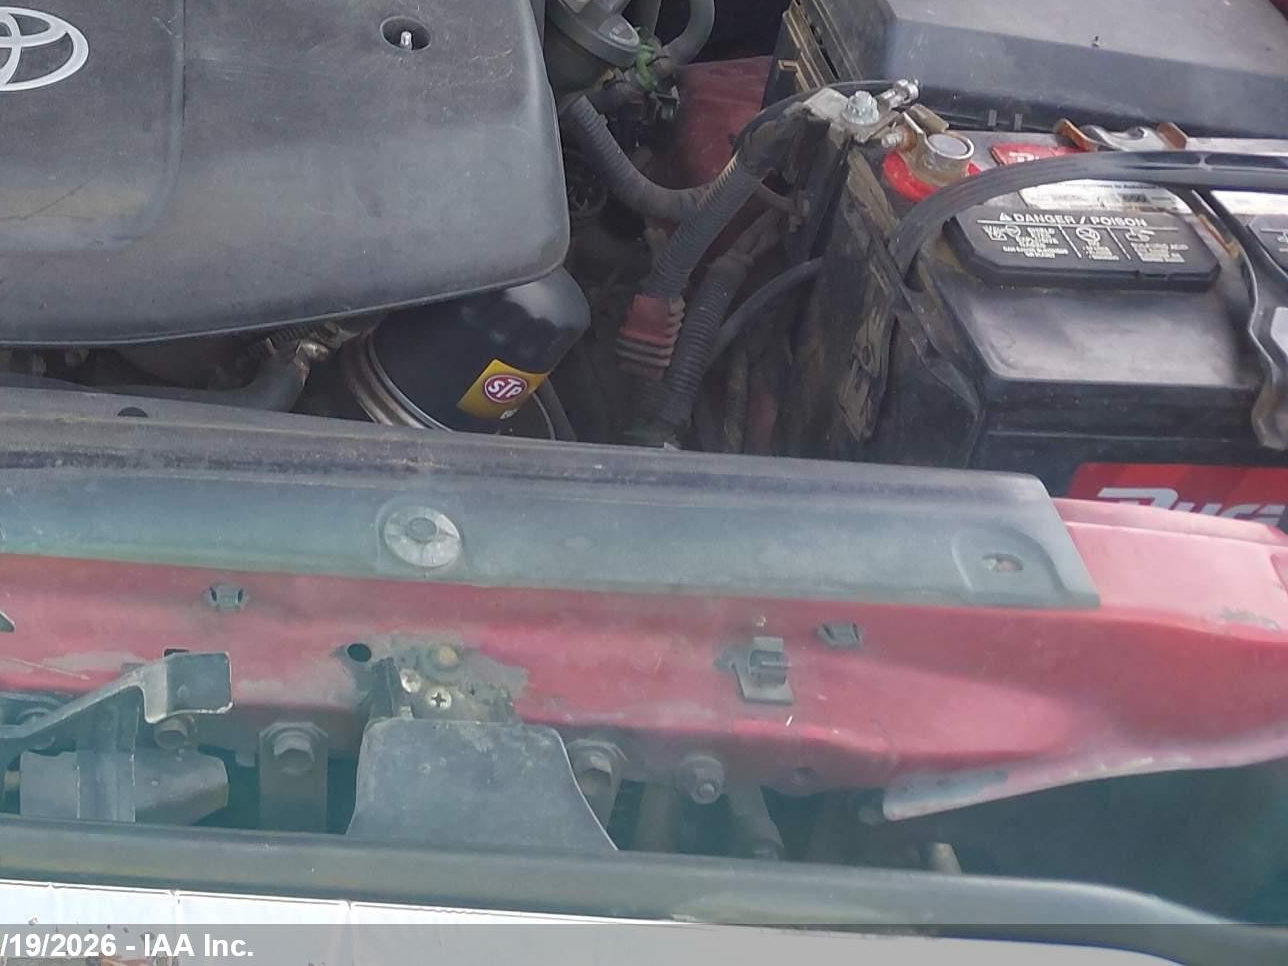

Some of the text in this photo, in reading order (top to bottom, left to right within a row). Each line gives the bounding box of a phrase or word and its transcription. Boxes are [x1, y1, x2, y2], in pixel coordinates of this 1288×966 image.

[1013, 213, 1076, 224] DANGER
[1091, 216, 1148, 227] POISON
[487, 378, 523, 398] STP
